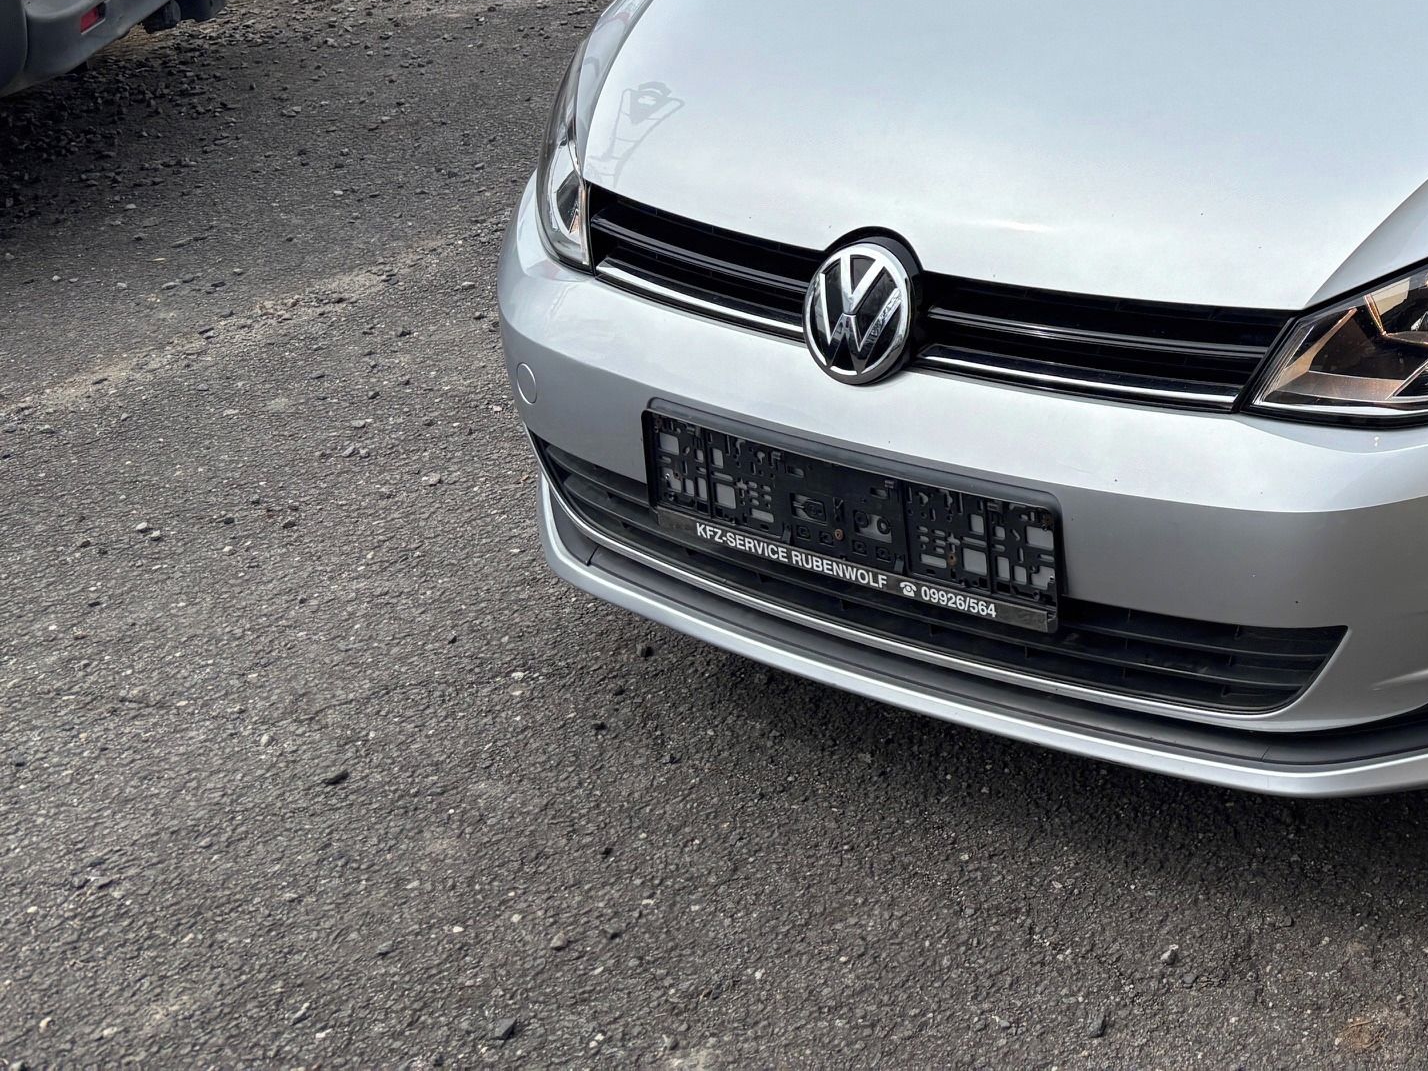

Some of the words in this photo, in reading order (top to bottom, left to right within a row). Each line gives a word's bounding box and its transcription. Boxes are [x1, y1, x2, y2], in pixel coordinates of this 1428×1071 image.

[808, 243, 908, 379] VW
[696, 523, 788, 562] KFZ-SERVICE
[791, 550, 887, 588] RUBENWOLF
[921, 586, 997, 618] 09926/564
